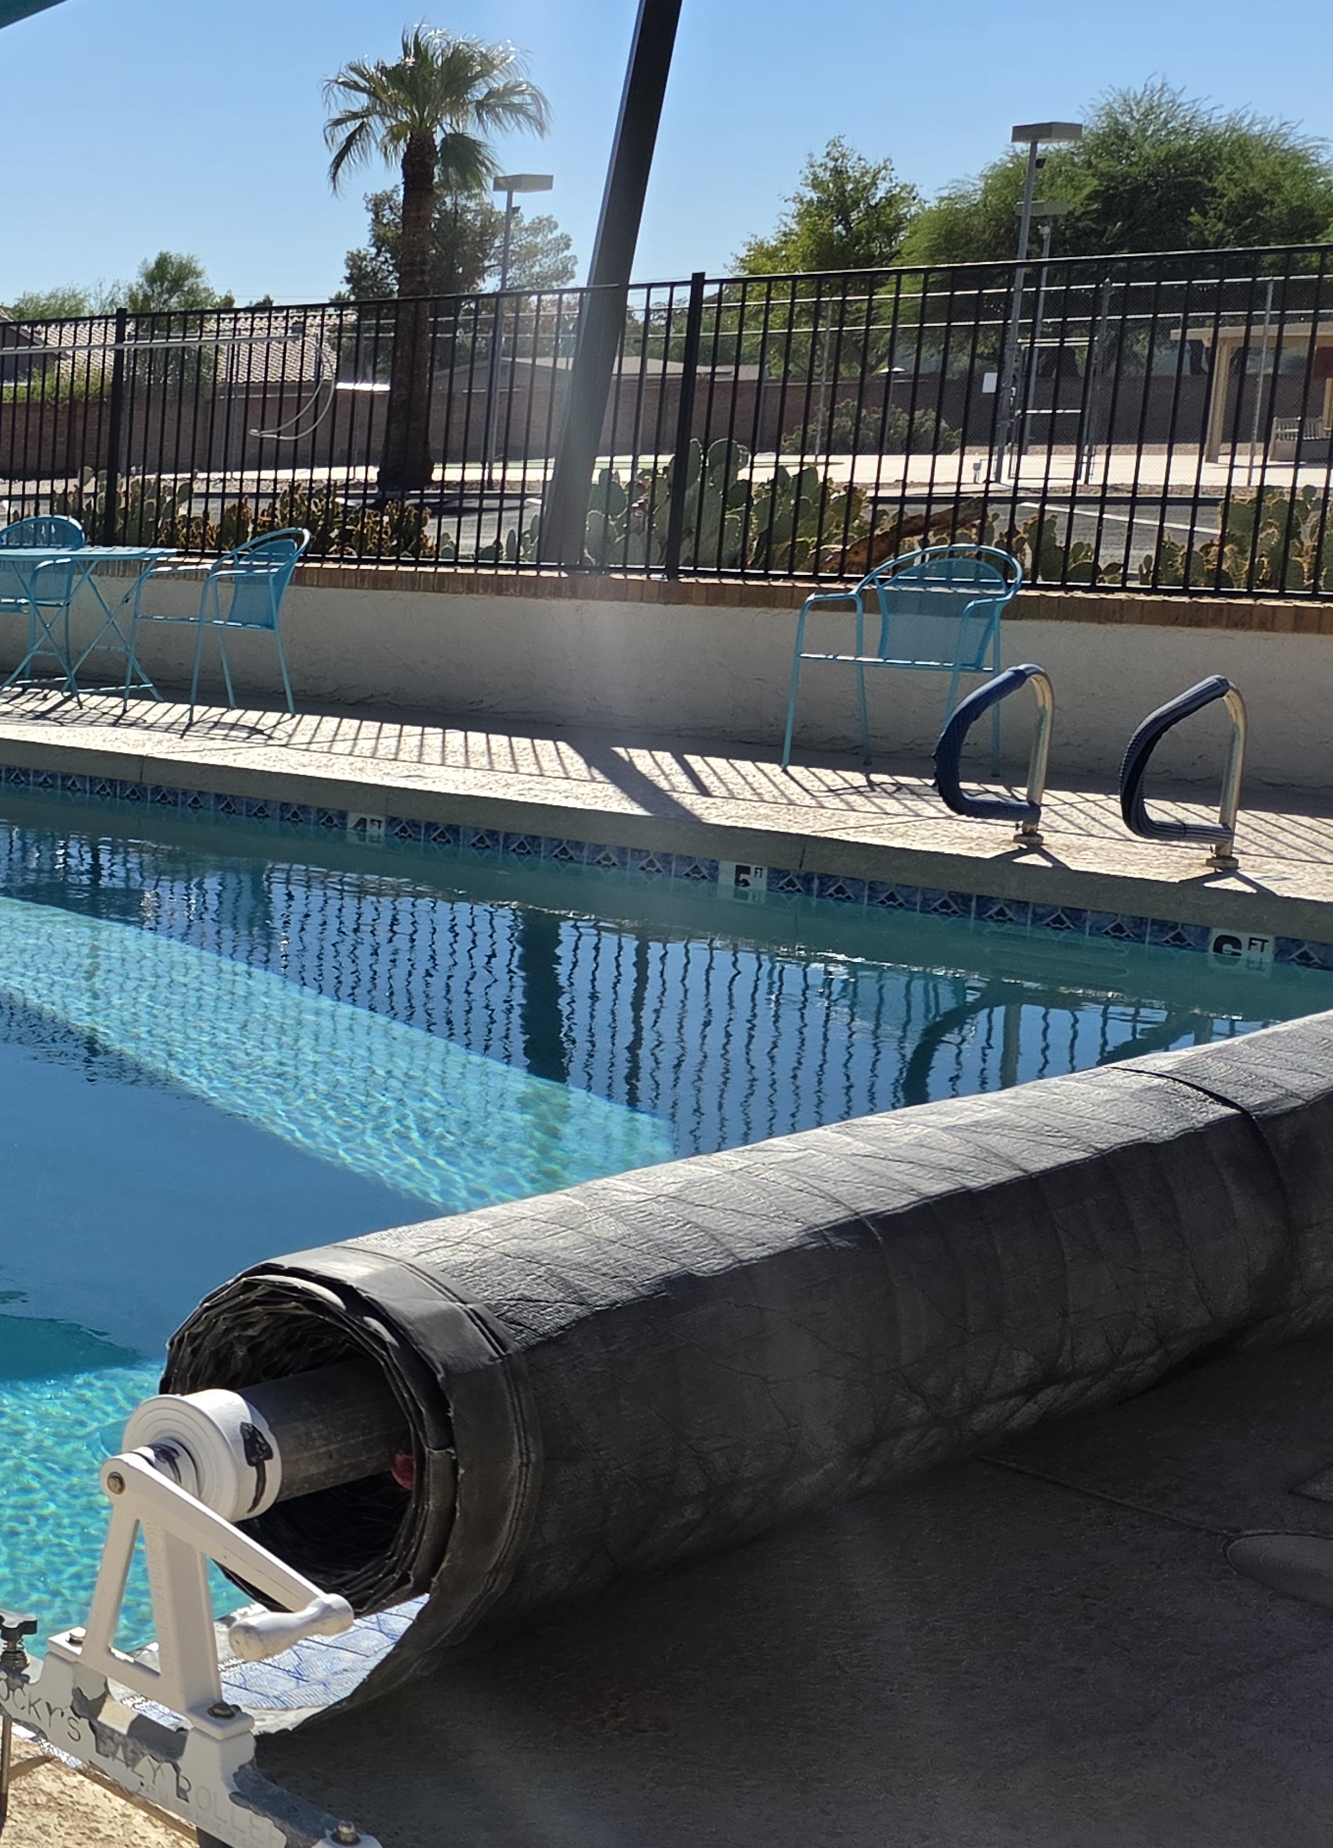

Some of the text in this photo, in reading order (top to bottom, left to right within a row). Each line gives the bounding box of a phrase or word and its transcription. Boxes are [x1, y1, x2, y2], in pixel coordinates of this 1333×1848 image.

[735, 864, 764, 888] 5 FT
[1248, 937, 1270, 953] FT
